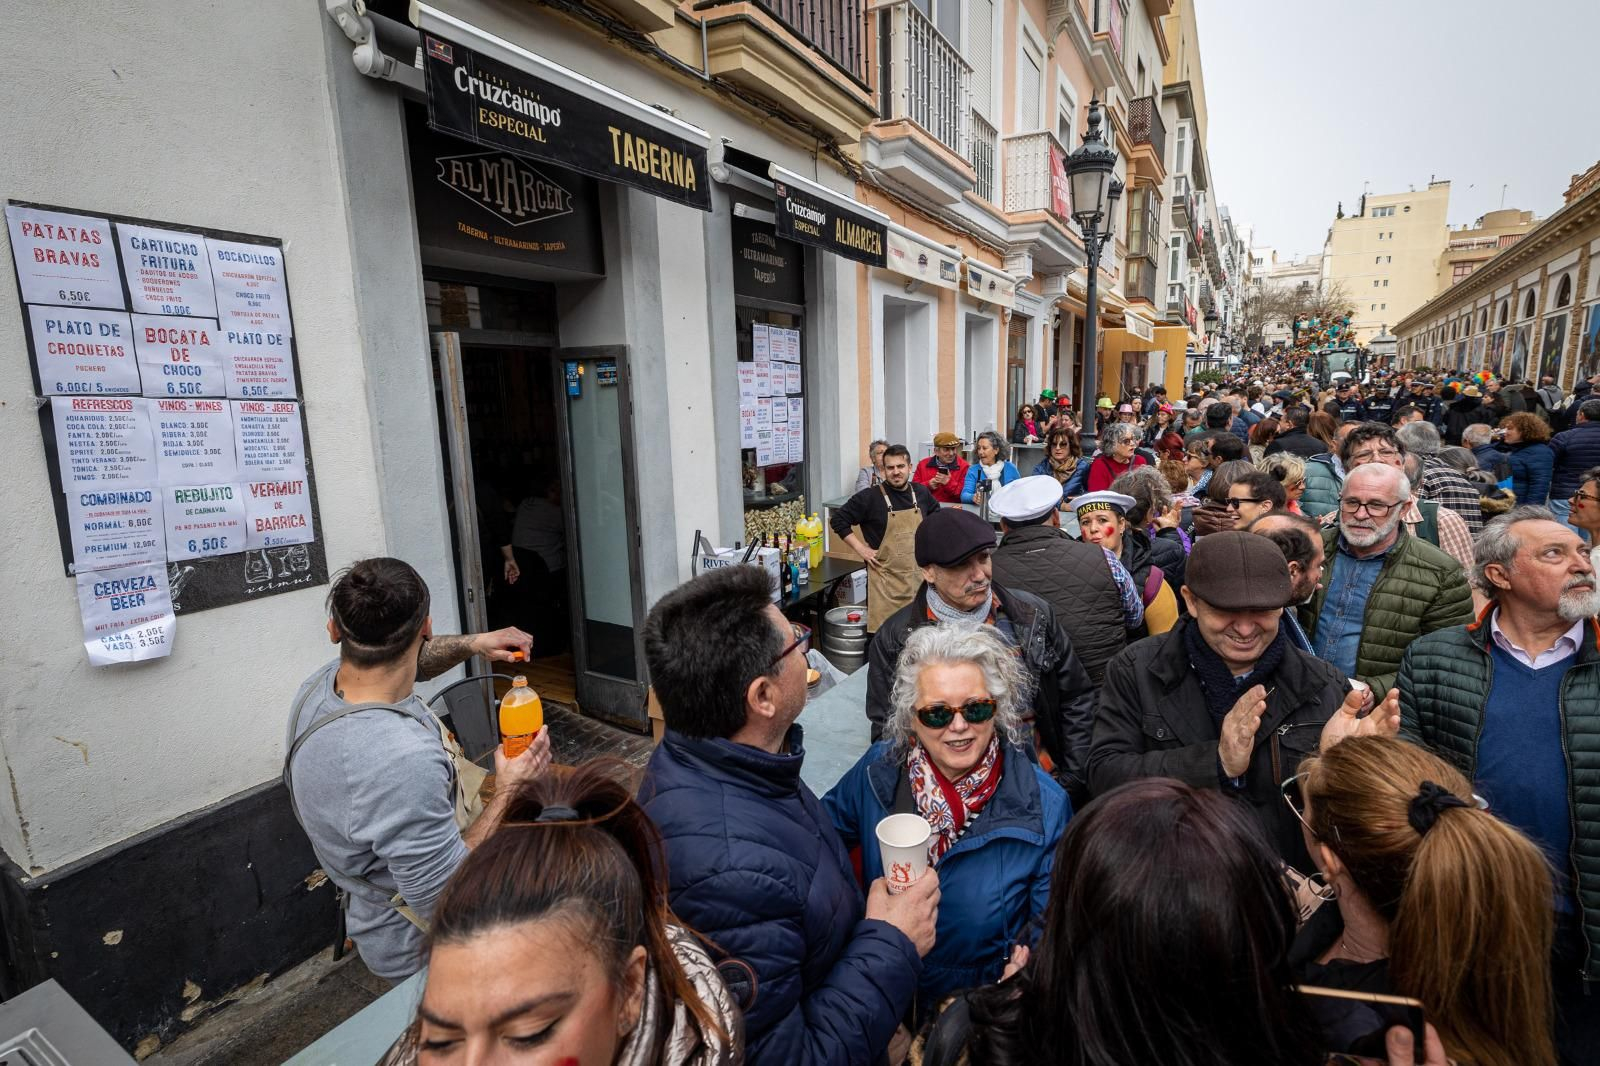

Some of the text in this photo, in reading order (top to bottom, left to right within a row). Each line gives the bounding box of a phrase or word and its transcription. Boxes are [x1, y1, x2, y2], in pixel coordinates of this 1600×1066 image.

[454, 66, 560, 126] Cruzcampo
[479, 107, 546, 143] ESPECIAL
[608, 126, 696, 191] TABERNA
[450, 158, 563, 216] ALMARCEN
[786, 197, 826, 225] Cruzcampo
[22, 222, 102, 244] PATATAS
[457, 222, 488, 241] TABERNA
[795, 220, 820, 237] ESPECIAL
[836, 218, 882, 255] ALMARCEN
[130, 237, 198, 256] CARTUCHO
[752, 232, 776, 249] TABERNA
[33, 248, 100, 268] BRAVAS
[140, 255, 195, 271] FRITURA
[218, 250, 276, 266] BOCADILLOS
[46, 320, 120, 337] PLATO DE
[145, 328, 210, 346] BOCATA
[228, 332, 283, 346] PLATO DE
[48, 342, 125, 357] CROQUETAS
[171, 348, 190, 362] DE
[163, 364, 202, 376] CHOCO
[97, 382, 103, 392] 5
[72, 399, 133, 410] REFRESCOS
[158, 401, 223, 411] VINOS WINES
[240, 402, 295, 412] VINOS JEREZ
[175, 486, 233, 504] REBUJITO
[250, 480, 303, 498] VERMUT
[80, 491, 153, 507] COMBINADO
[274, 502, 283, 510] DE
[195, 506, 227, 515] CARNAVAL
[1077, 502, 1111, 516] MARINE
[256, 514, 306, 532] BARRICA
[94, 576, 157, 597] CERVEZA
[244, 574, 313, 593] vermut
[110, 593, 146, 611] BEER
